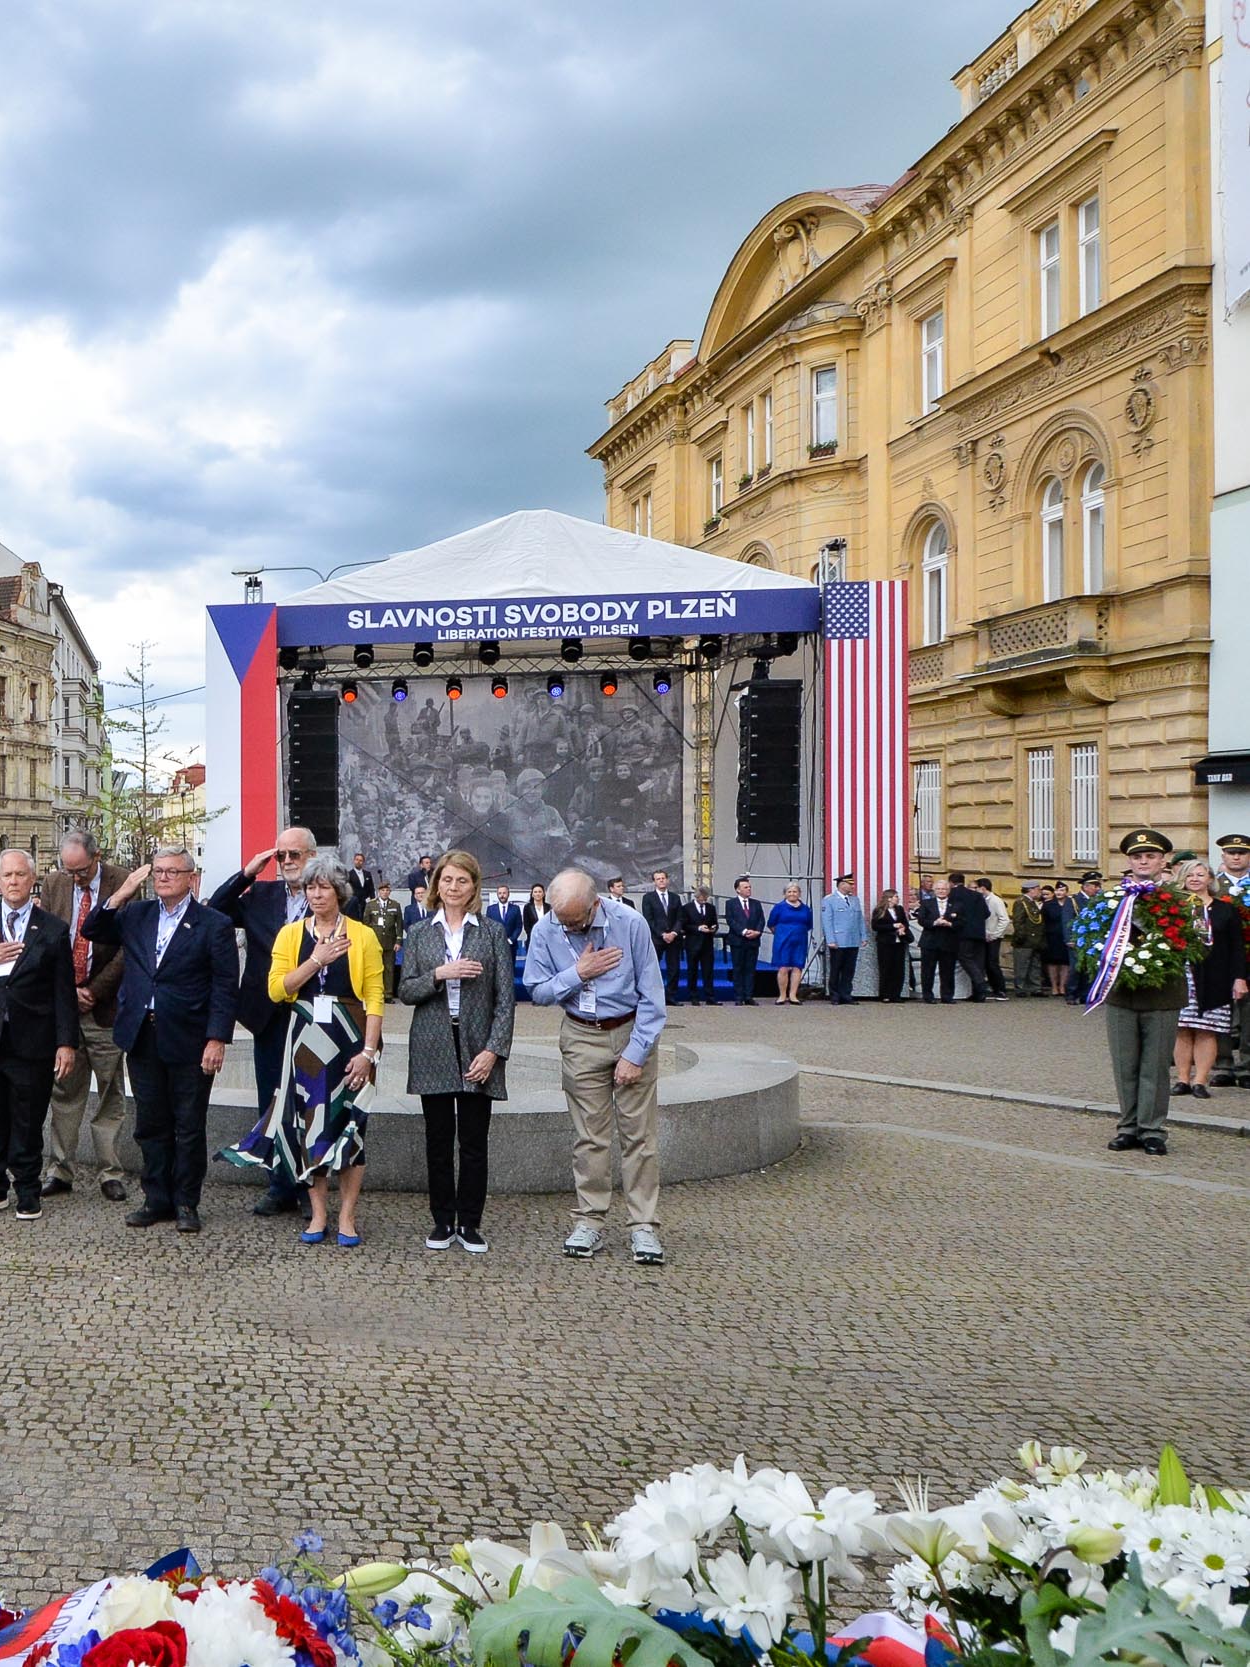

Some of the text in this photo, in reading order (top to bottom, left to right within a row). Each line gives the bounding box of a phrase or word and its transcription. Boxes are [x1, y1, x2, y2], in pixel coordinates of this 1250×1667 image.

[347, 592, 737, 629] SLAVNOSTI SVOBODY PLZEŇ
[437, 624, 639, 640] LIBERATION FESTIVAL PILSEN
